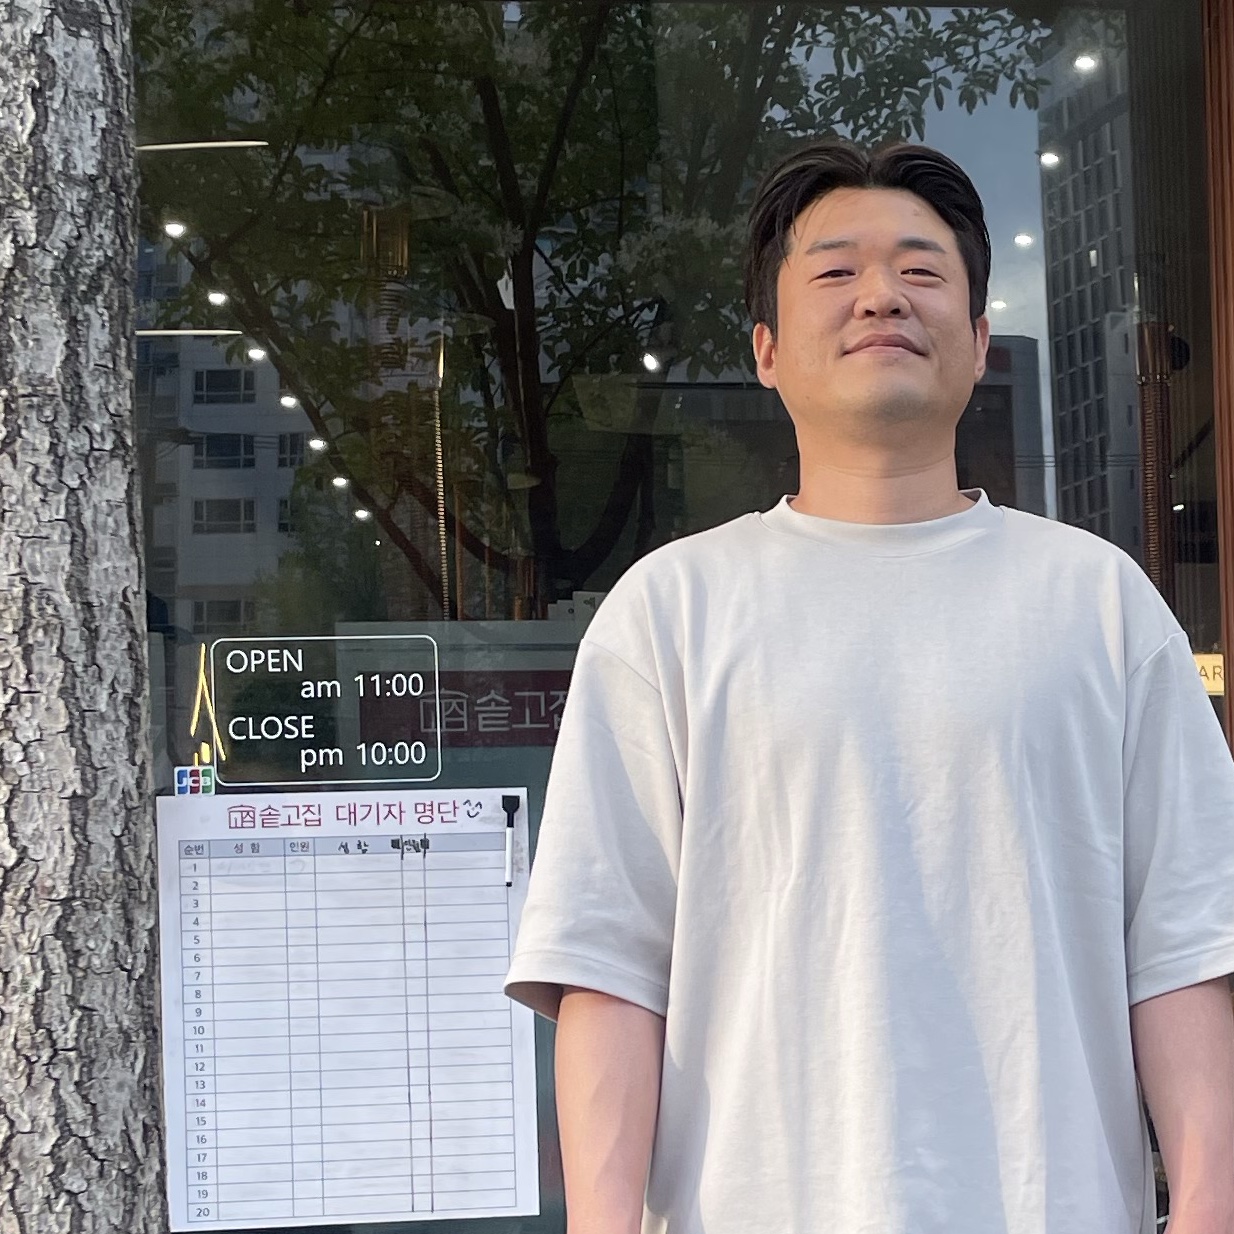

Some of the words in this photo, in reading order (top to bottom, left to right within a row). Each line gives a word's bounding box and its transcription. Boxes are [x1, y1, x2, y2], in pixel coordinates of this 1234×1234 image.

[226, 649, 303, 673] OPEN
[300, 679, 341, 698] am
[353, 673, 424, 697] 11:00
[228, 715, 315, 740] CLOSE
[300, 746, 344, 773] pm
[356, 741, 426, 766] 10:00
[259, 804, 322, 828] 솥고집
[335, 801, 407, 826] 대기자
[414, 800, 460, 825] 명단
[192, 881, 198, 890] 2
[192, 899, 198, 908] 3
[193, 917, 200, 926] 4
[193, 935, 200, 944] 5
[193, 953, 200, 963] 6
[194, 971, 201, 980] 7
[194, 989, 202, 999] 8
[195, 1007, 202, 1017] 9
[193, 1025, 205, 1035] 10
[195, 1043, 204, 1053] 11
[194, 1062, 205, 1072] 12
[195, 1080, 206, 1089] 13
[195, 1098, 206, 1108] 14
[195, 1116, 207, 1126] 15
[196, 1134, 207, 1144] 16
[197, 1153, 208, 1162] 17
[197, 1171, 208, 1181] 18
[197, 1189, 208, 1199] 19
[196, 1207, 210, 1218] 20
